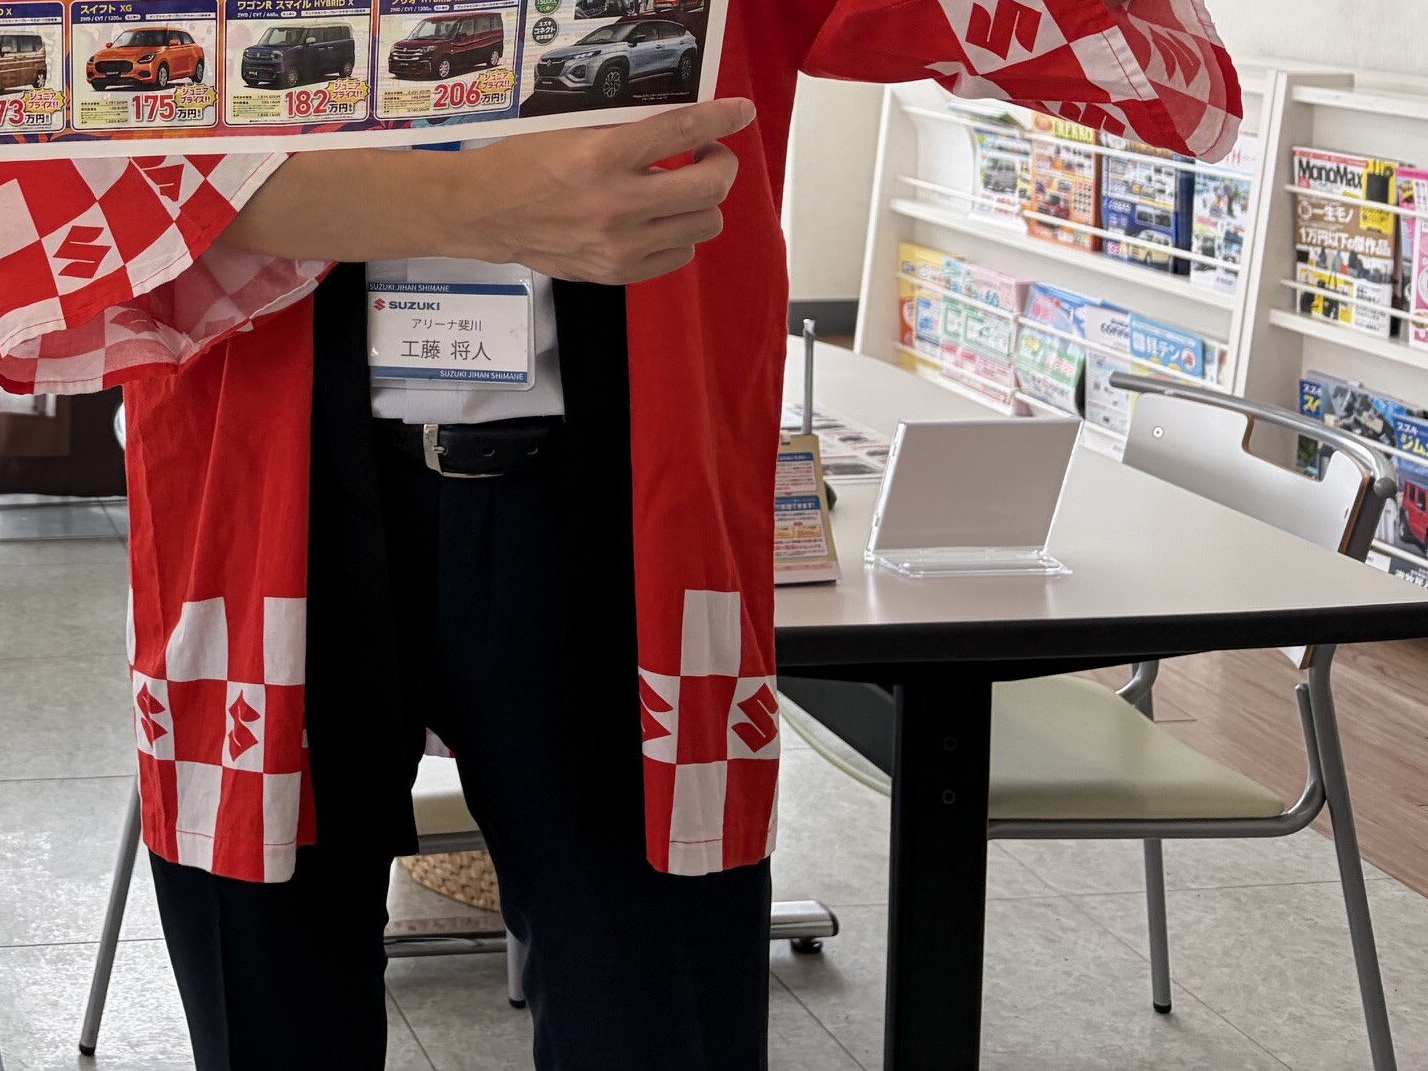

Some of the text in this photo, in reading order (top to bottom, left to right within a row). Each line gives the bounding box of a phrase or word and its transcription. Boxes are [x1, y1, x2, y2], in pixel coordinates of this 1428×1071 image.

[80, 4, 133, 13] スイフト XG
[237, 0, 345, 11] ワゴンR スマイル HYBRID
[533, 27, 556, 35] コネクト
[1298, 159, 1362, 189] MonoMax
[388, 301, 440, 311] SUZUKI
[412, 319, 482, 332] アリーナ斐川
[401, 339, 492, 361] 工藤 将人
[491, 372, 524, 380] SHIMANE
